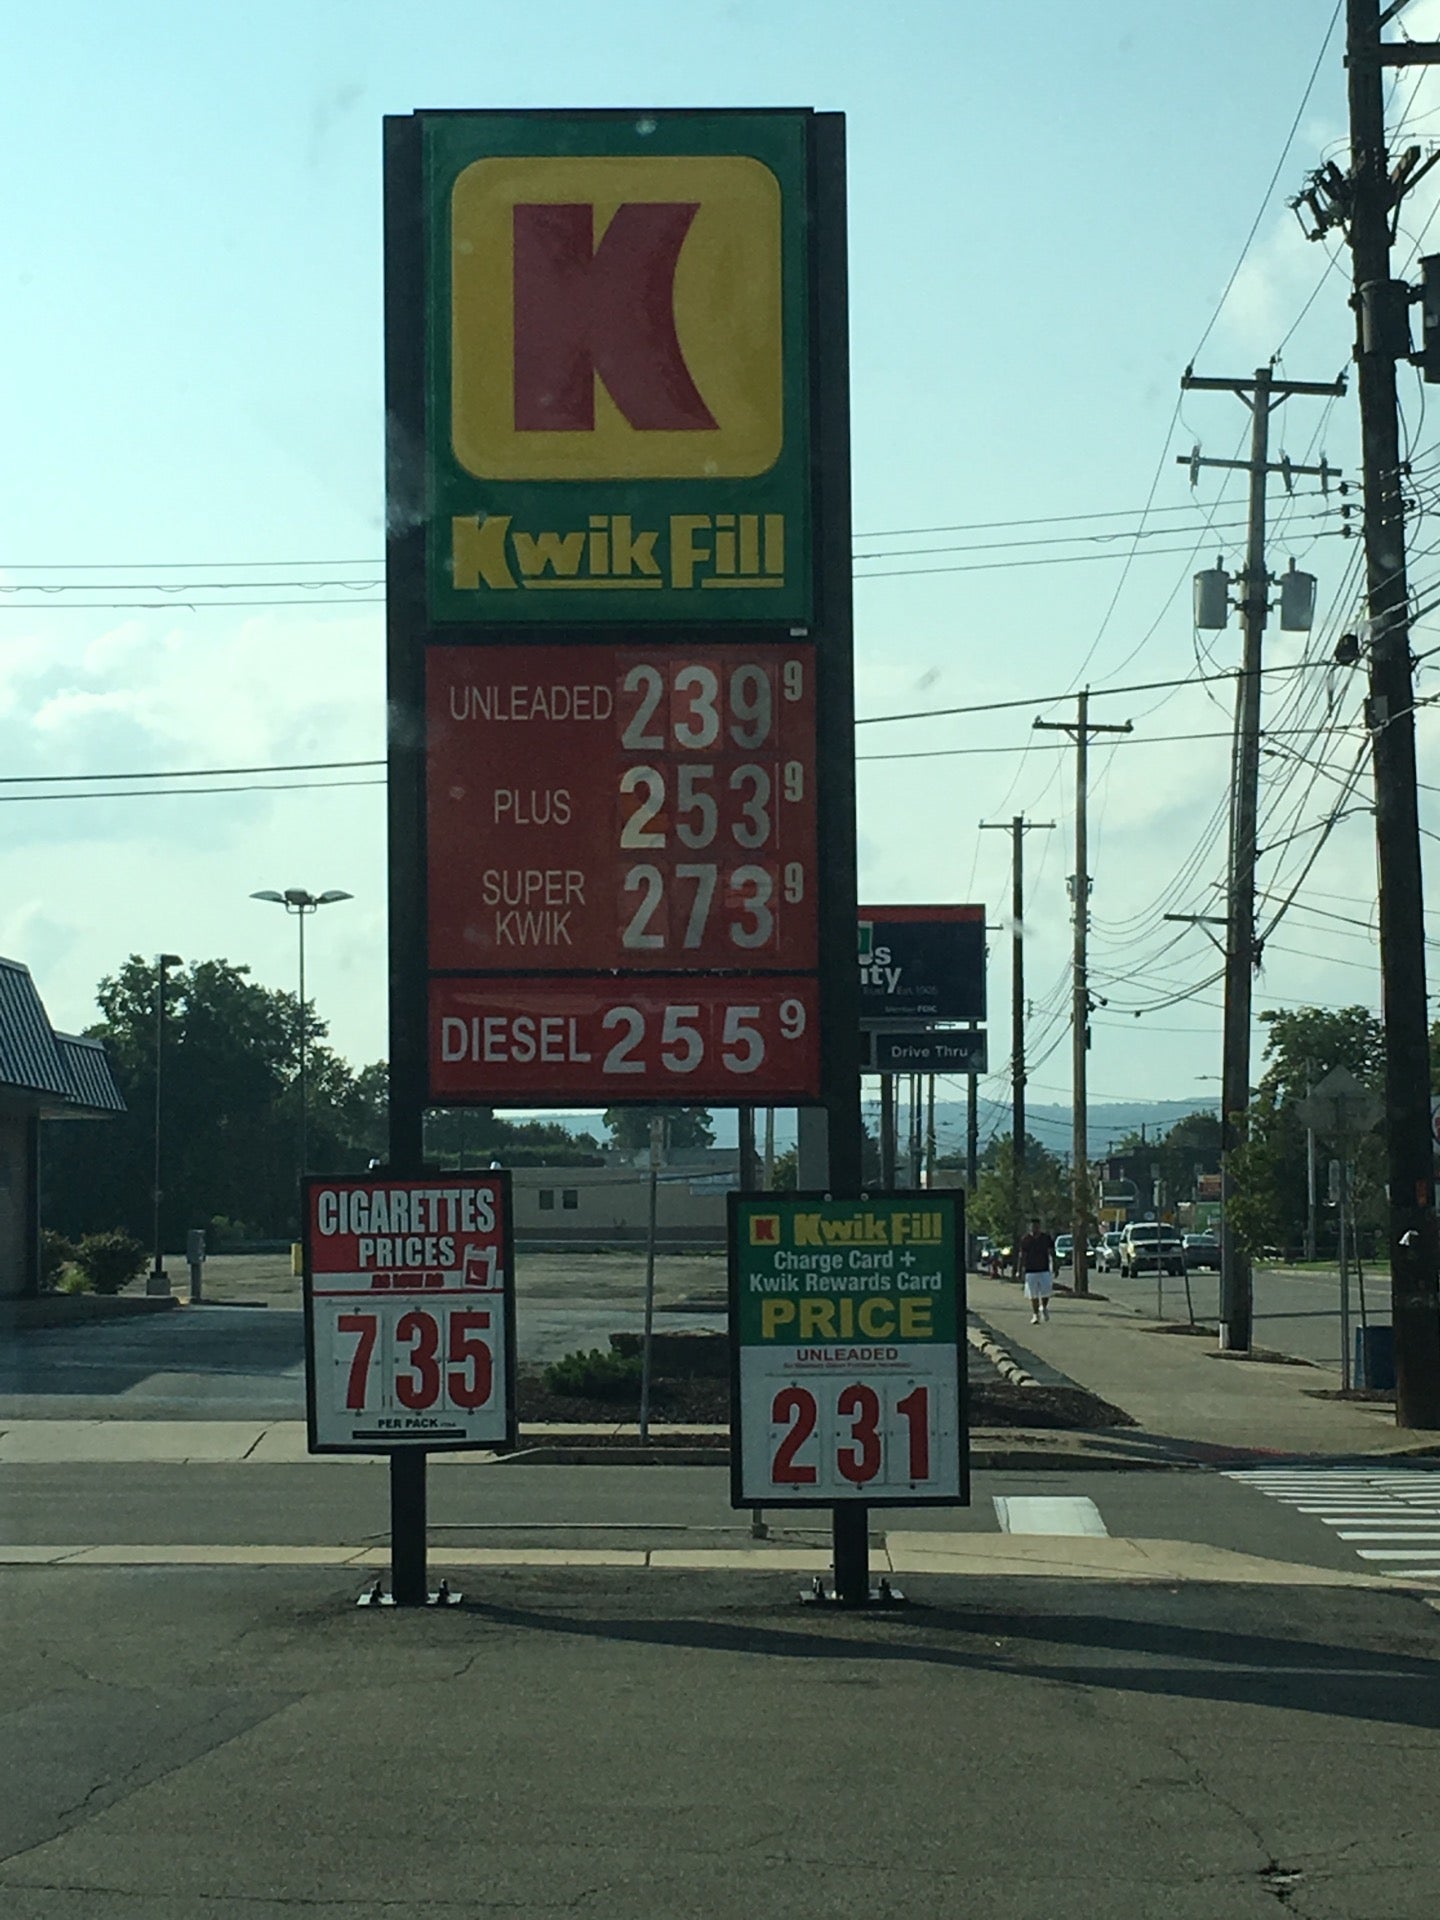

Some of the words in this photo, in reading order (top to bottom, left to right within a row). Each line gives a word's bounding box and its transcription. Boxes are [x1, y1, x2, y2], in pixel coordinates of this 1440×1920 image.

[513, 202, 721, 431] K
[452, 515, 662, 589] Kwik
[670, 515, 784, 588] Fill
[450, 685, 613, 720] UNLEADED
[621, 664, 771, 750] 239
[494, 788, 571, 825] PLUS
[620, 764, 771, 849] 253
[482, 870, 585, 905] SUPER
[622, 864, 774, 949] 273
[496, 911, 572, 945] KWIK
[441, 1017, 592, 1062] DIESEL
[602, 1006, 765, 1074] 255
[779, 999, 806, 1039] 9
[891, 1046, 931, 1058] Drive
[935, 1046, 969, 1058] Thru
[318, 1188, 496, 1236] CIGARETTES
[794, 1213, 889, 1245] Kwik
[892, 1213, 942, 1245] Fill
[359, 1236, 456, 1267] PRICES
[774, 1250, 843, 1273] Charge
[849, 1250, 894, 1270] Card
[750, 1274, 800, 1292] Kwik
[806, 1272, 891, 1292] Rewards
[897, 1271, 942, 1290] Card
[762, 1298, 934, 1338] PRICE
[338, 1311, 492, 1410] 735
[796, 1348, 899, 1362] UNLEADED
[378, 1419, 402, 1429] PER
[406, 1418, 439, 1428] PACK
[772, 1384, 929, 1484] 231
